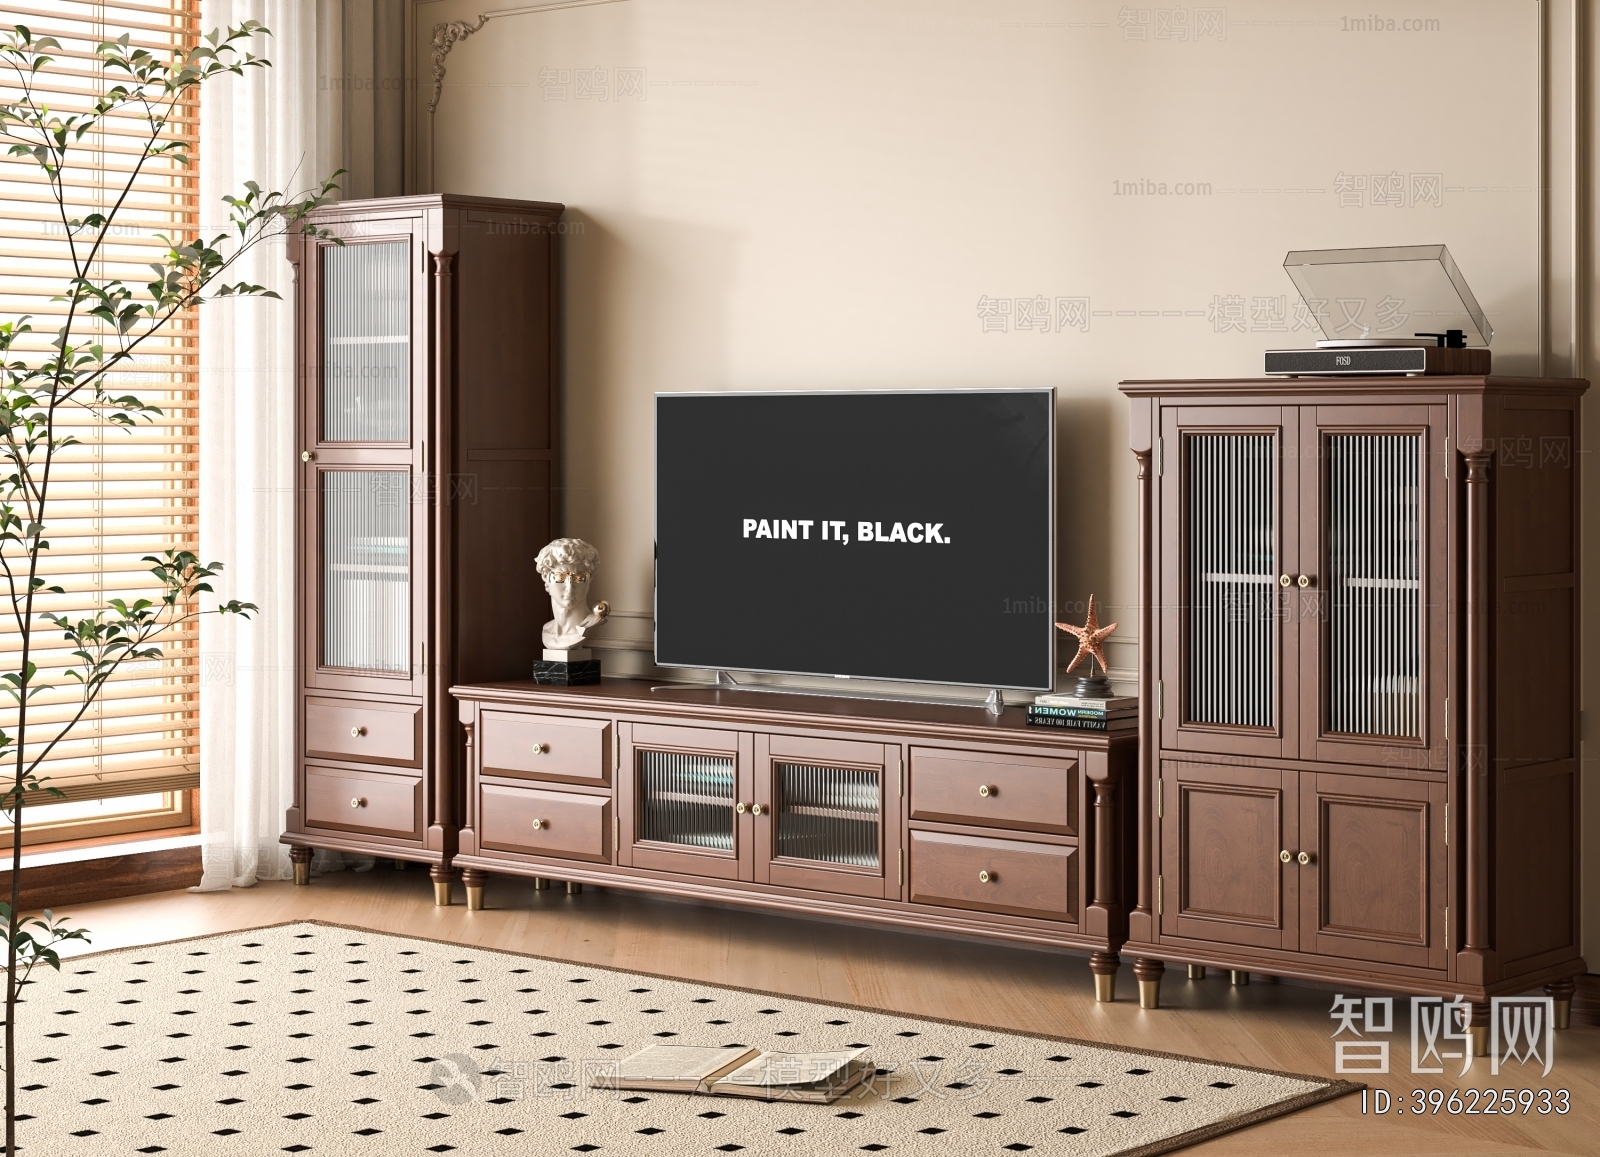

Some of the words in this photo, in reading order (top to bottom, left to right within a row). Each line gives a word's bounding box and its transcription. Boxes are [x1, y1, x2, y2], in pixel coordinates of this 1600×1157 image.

[743, 518, 814, 540] PAINT
[821, 520, 849, 546] IT,
[857, 521, 951, 544] BLACK.
